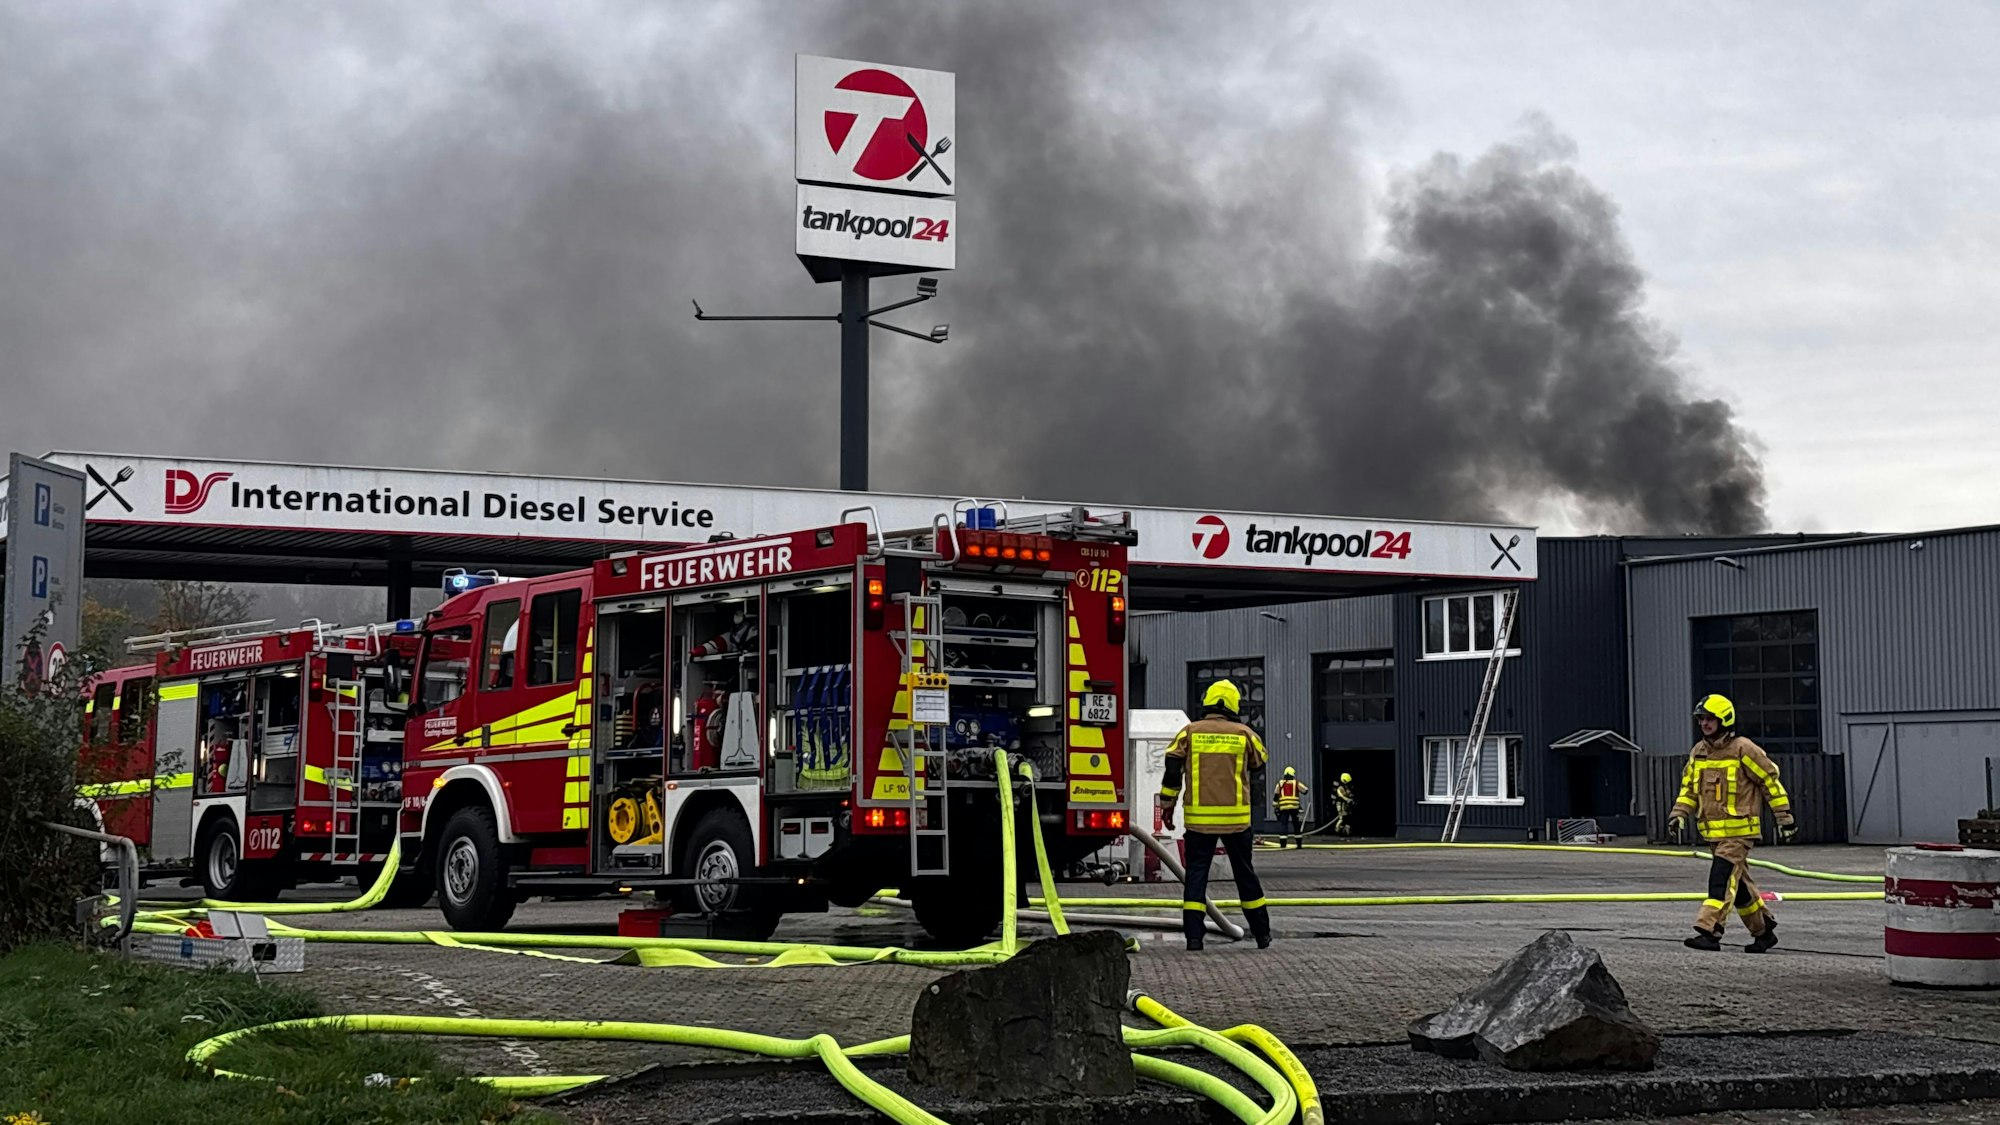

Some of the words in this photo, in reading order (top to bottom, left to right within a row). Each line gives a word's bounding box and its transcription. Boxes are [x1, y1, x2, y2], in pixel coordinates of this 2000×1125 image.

[803, 205, 950, 242] tankpool24
[231, 482, 470, 517] International
[483, 493, 585, 523] Diesel
[597, 498, 714, 528] Service
[1246, 523, 1412, 566] tankpool24
[640, 537, 793, 591] FEUERWEHR
[1090, 568, 1121, 593] 112
[190, 640, 263, 671] FEUERWEHR
[1087, 708, 1110, 720] 6822
[1092, 695, 1104, 706] RE
[883, 783, 895, 793] LF
[260, 827, 281, 850] 112
